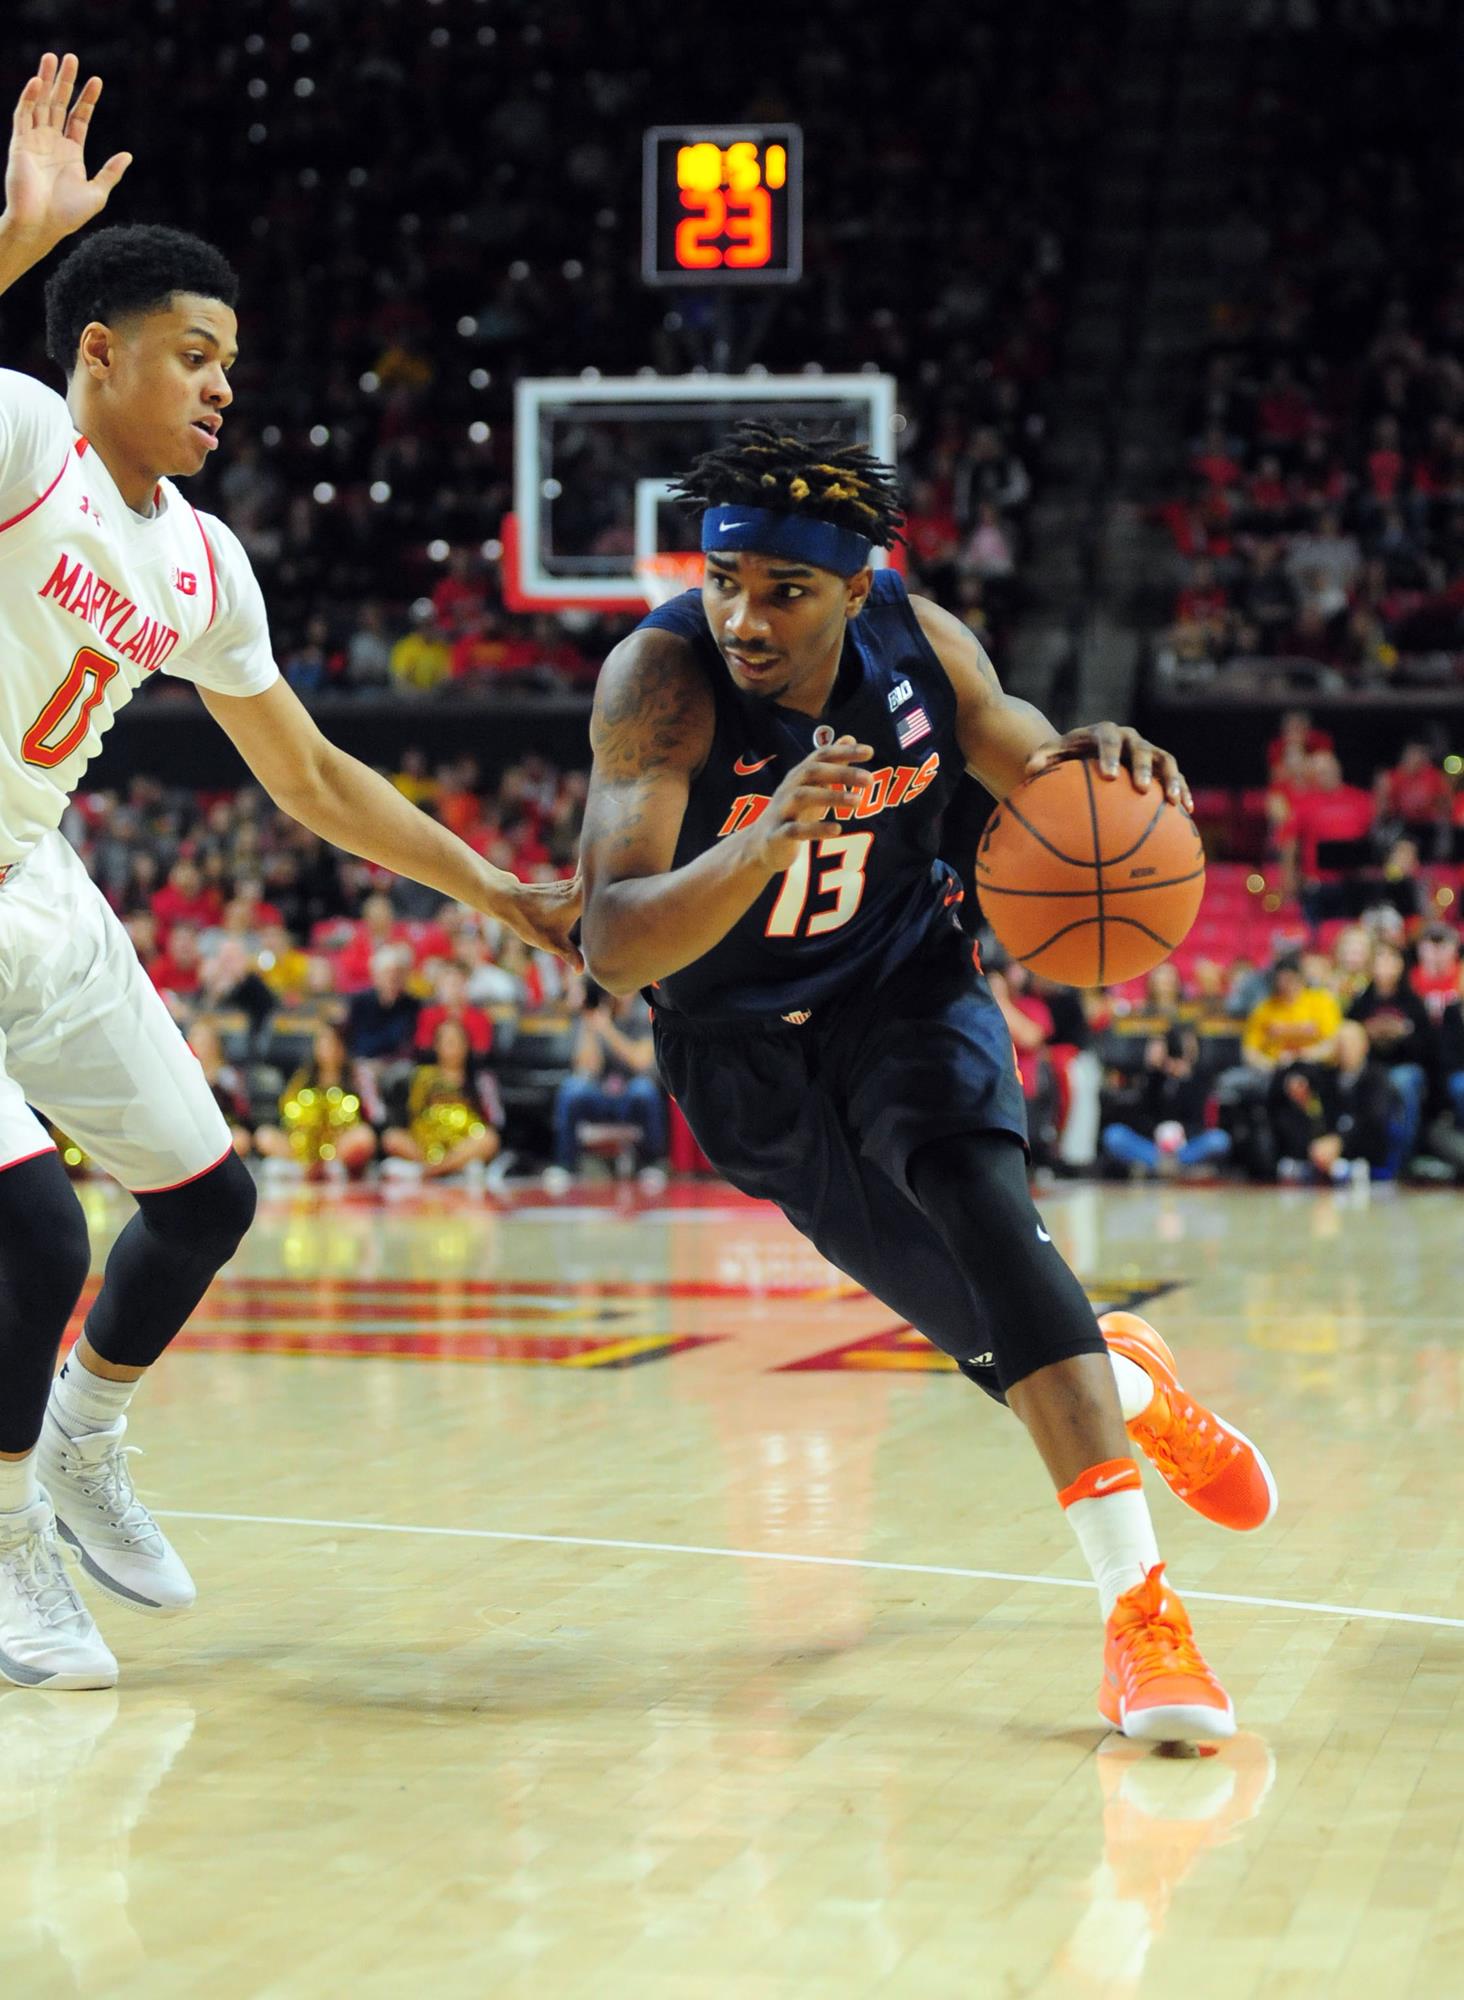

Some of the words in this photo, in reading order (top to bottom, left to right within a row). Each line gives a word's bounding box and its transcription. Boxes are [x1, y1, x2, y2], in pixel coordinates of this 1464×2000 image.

[676, 186, 771, 269] 23
[38, 552, 179, 671] MARYLAND
[21, 646, 119, 768] 0
[717, 752, 940, 837] ILNOIS
[764, 831, 875, 938] 13
